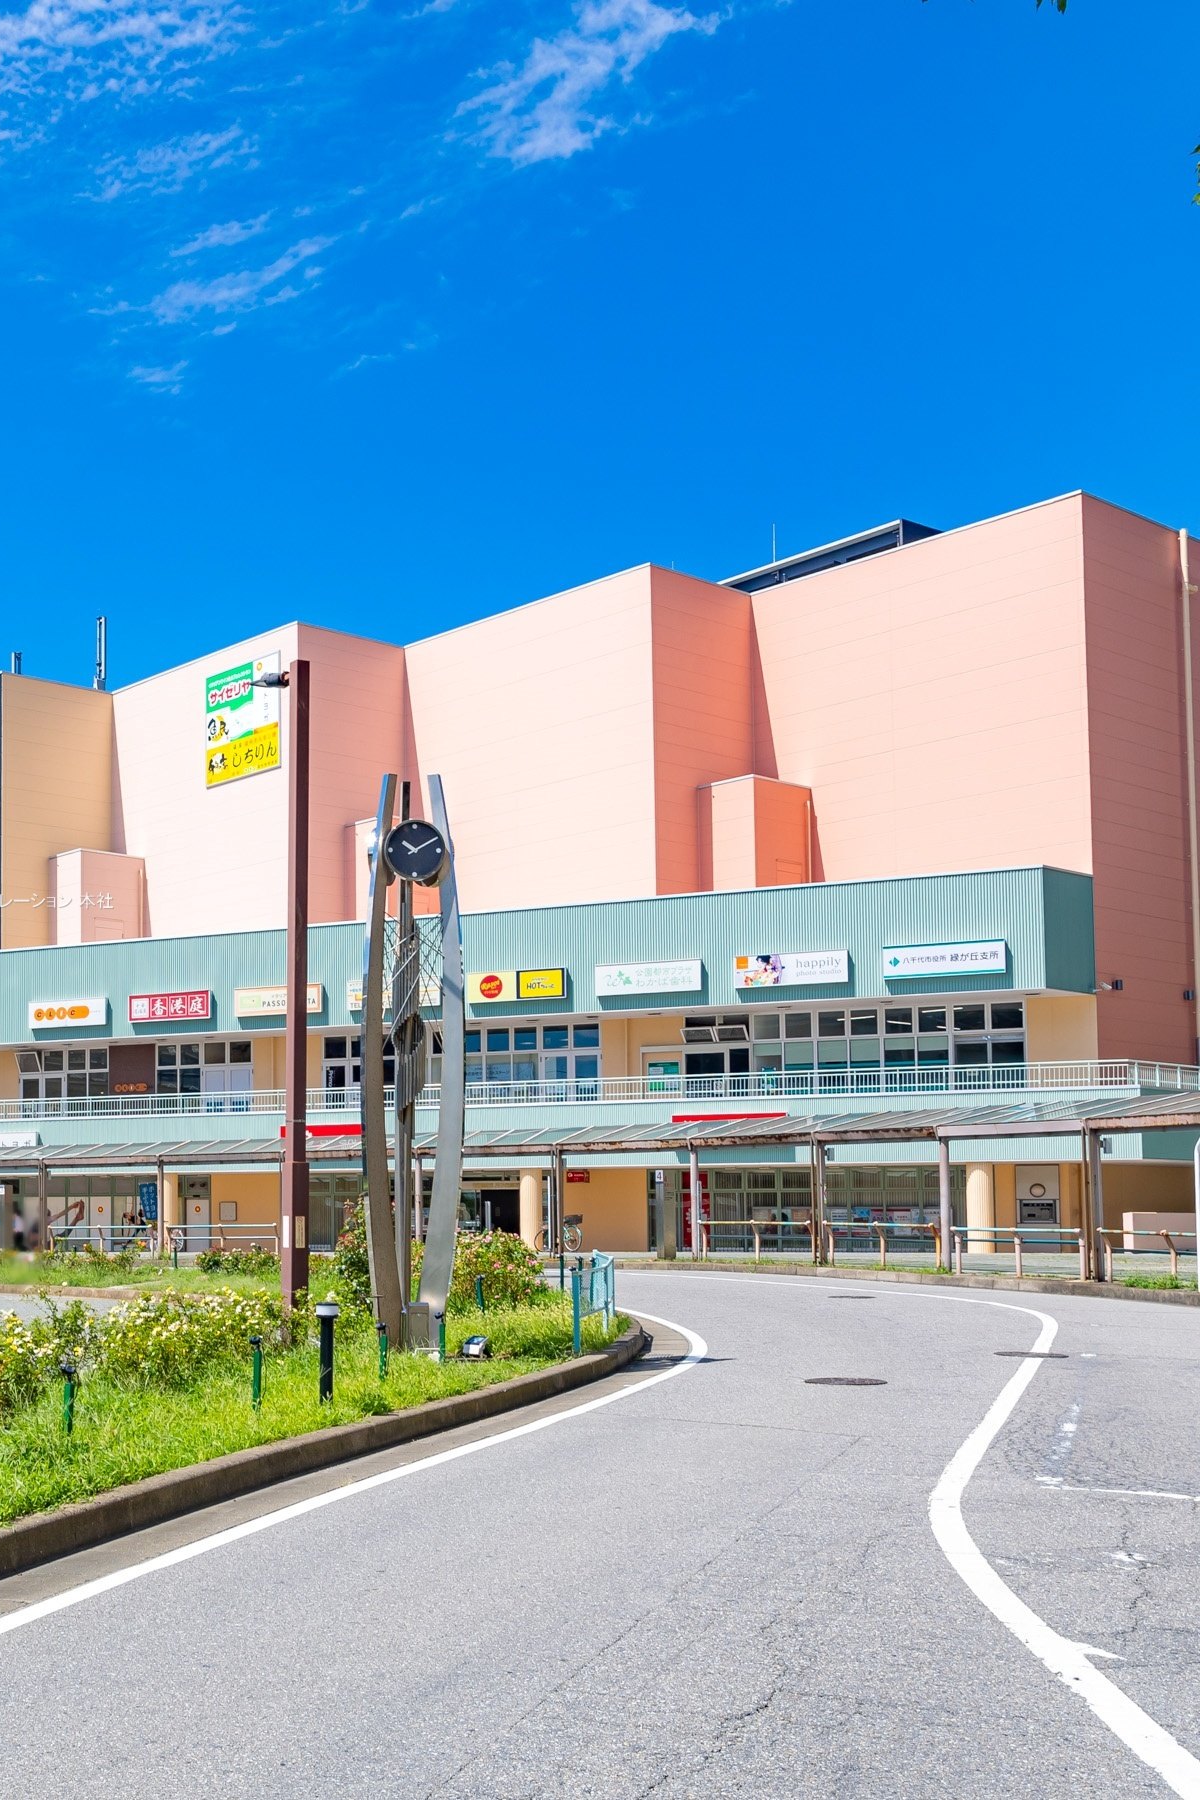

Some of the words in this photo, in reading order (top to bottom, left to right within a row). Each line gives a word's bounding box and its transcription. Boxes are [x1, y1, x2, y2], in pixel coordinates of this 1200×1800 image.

[209, 680, 251, 705] サイゼリヤ
[796, 956, 842, 969] happily
[902, 954, 947, 964] 八千代市役所
[949, 950, 999, 962] 緑が丘支所
[796, 968, 817, 977] photo
[818, 967, 842, 976] studio
[635, 975, 694, 987] わかば歯科
[151, 995, 206, 1016] 香港庭
[262, 1000, 286, 1008] PASSO
[656, 1171, 663, 1180] 4
